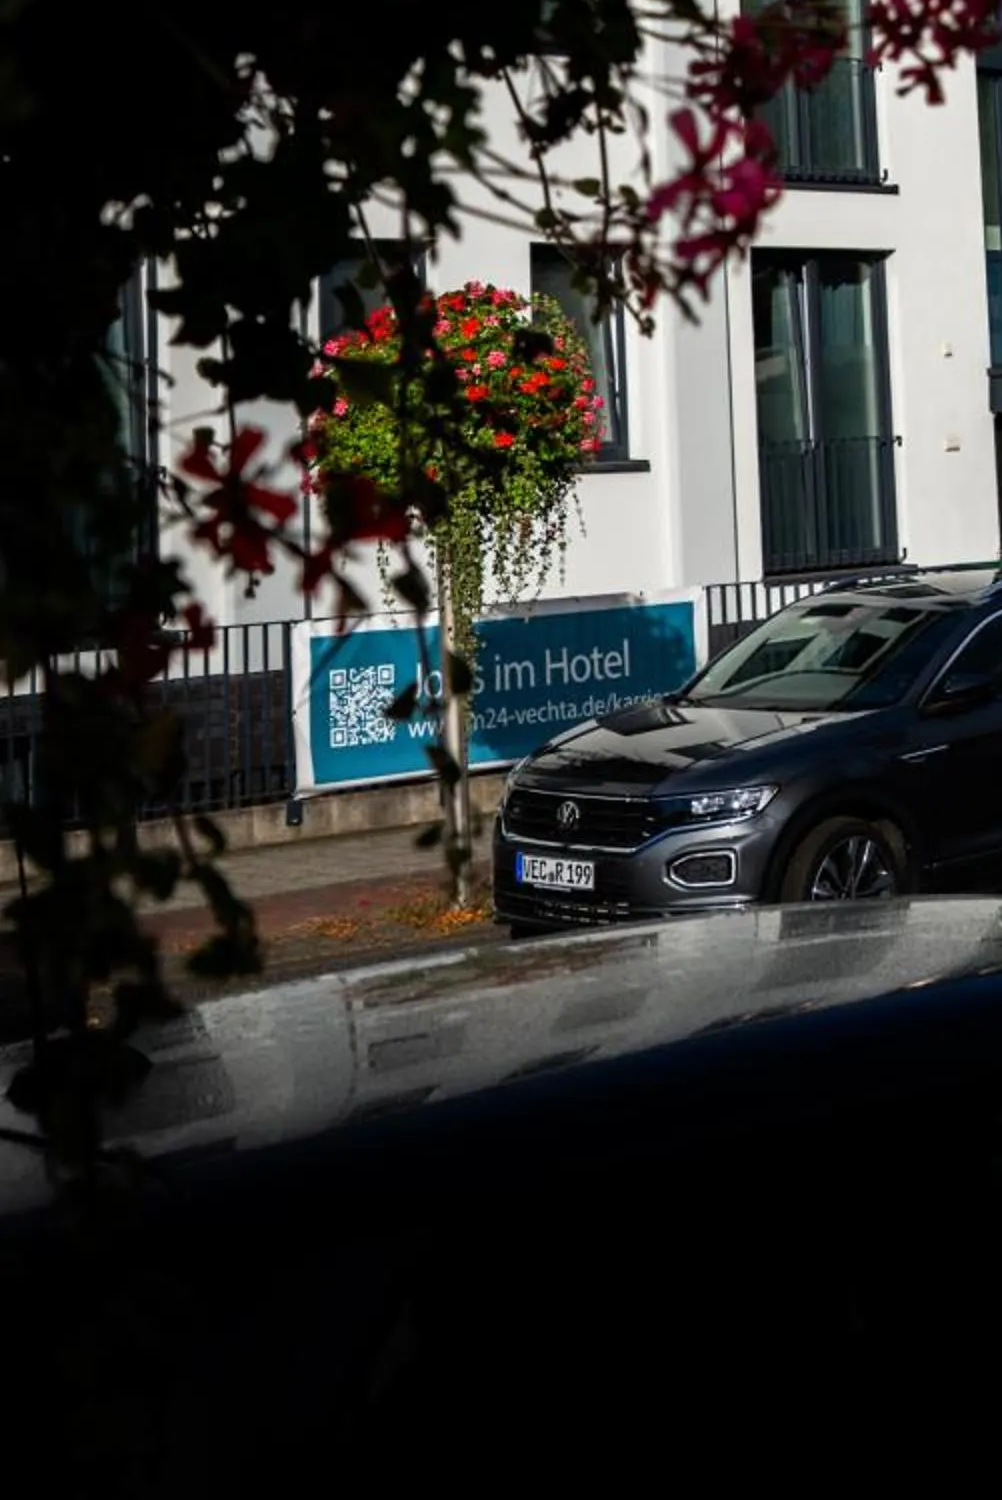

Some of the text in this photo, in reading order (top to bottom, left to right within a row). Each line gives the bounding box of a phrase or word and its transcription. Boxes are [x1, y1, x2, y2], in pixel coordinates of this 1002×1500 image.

[415, 639, 630, 699] Jos im Hotel
[523, 859, 548, 880] VEC
[567, 864, 592, 886] 199
